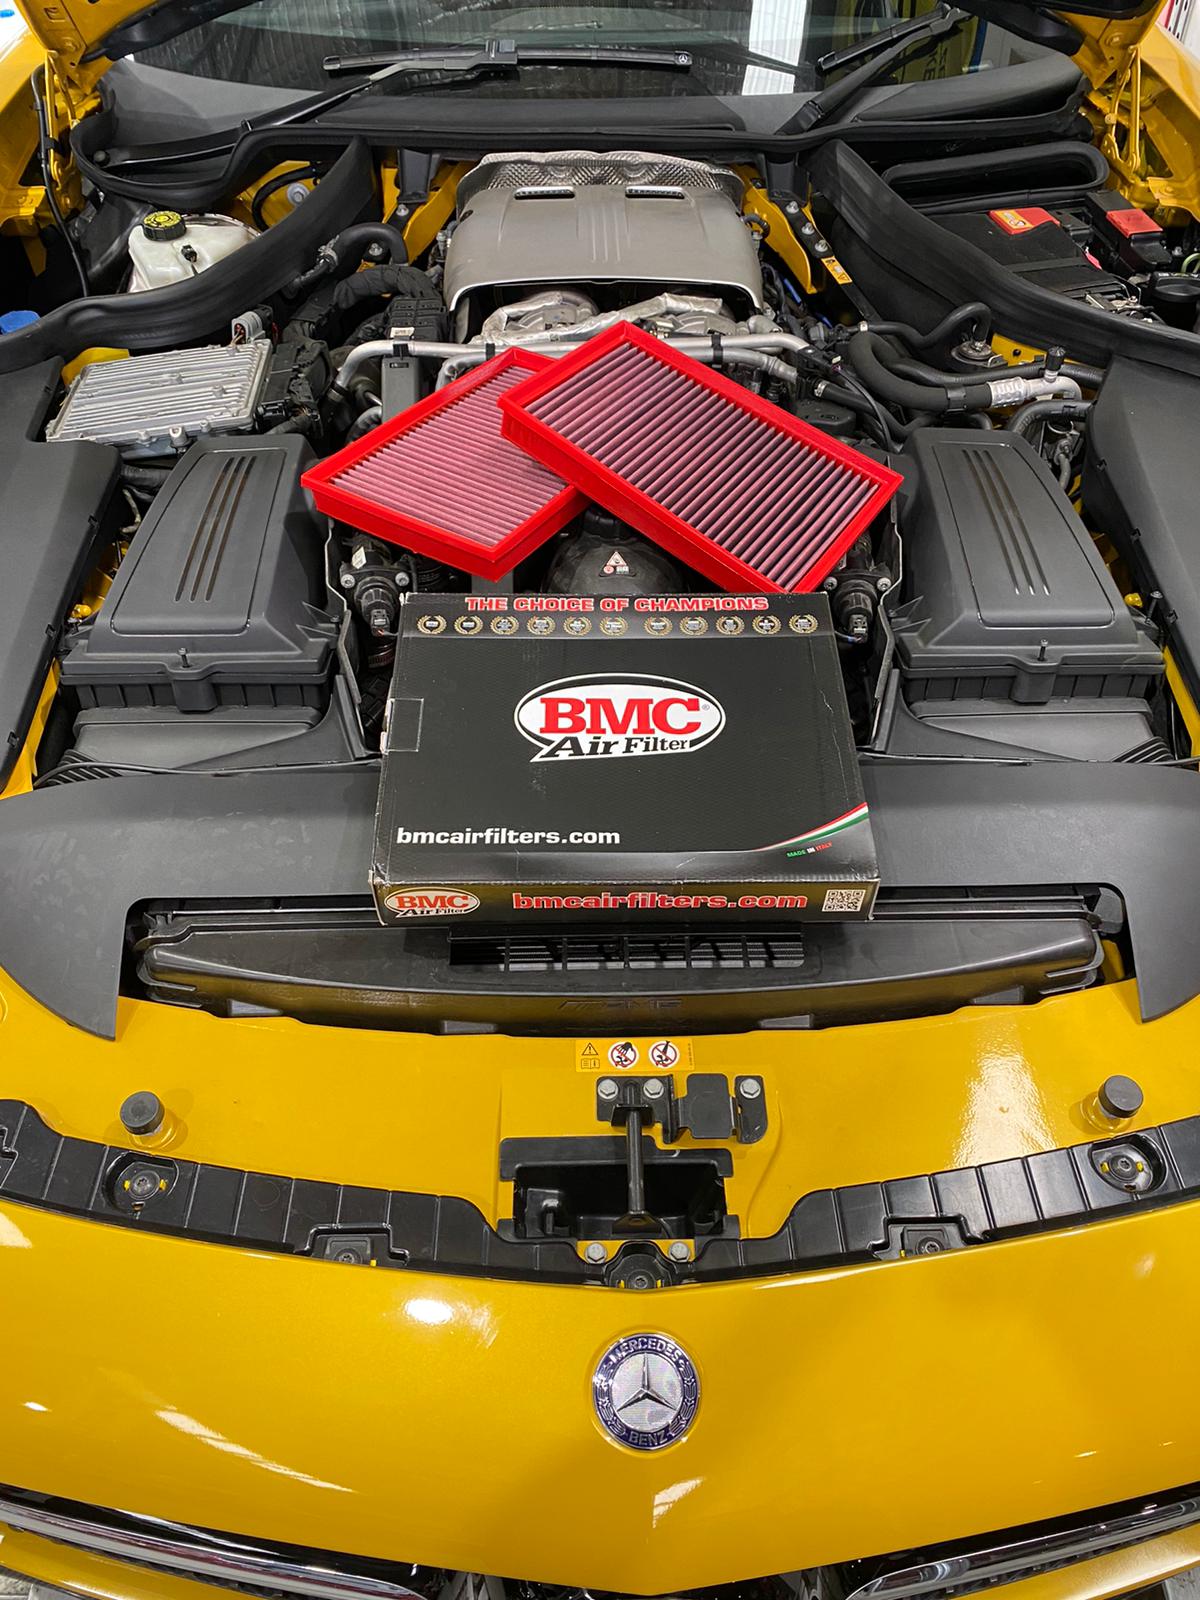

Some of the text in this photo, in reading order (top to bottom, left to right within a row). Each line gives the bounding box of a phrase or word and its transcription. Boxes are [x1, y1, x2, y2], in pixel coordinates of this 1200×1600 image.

[465, 597, 769, 612] THE CHOICE OF CHAMPIONS
[539, 698, 701, 734] BMC
[539, 736, 688, 759] Air Filter
[396, 827, 621, 844] bmcairfilters.com
[395, 895, 469, 908] BMC
[512, 892, 808, 909] bmcairfilters.com
[400, 908, 433, 916] Air
[609, 1338, 682, 1362] MERCEDES
[628, 1430, 668, 1446] BENZ
